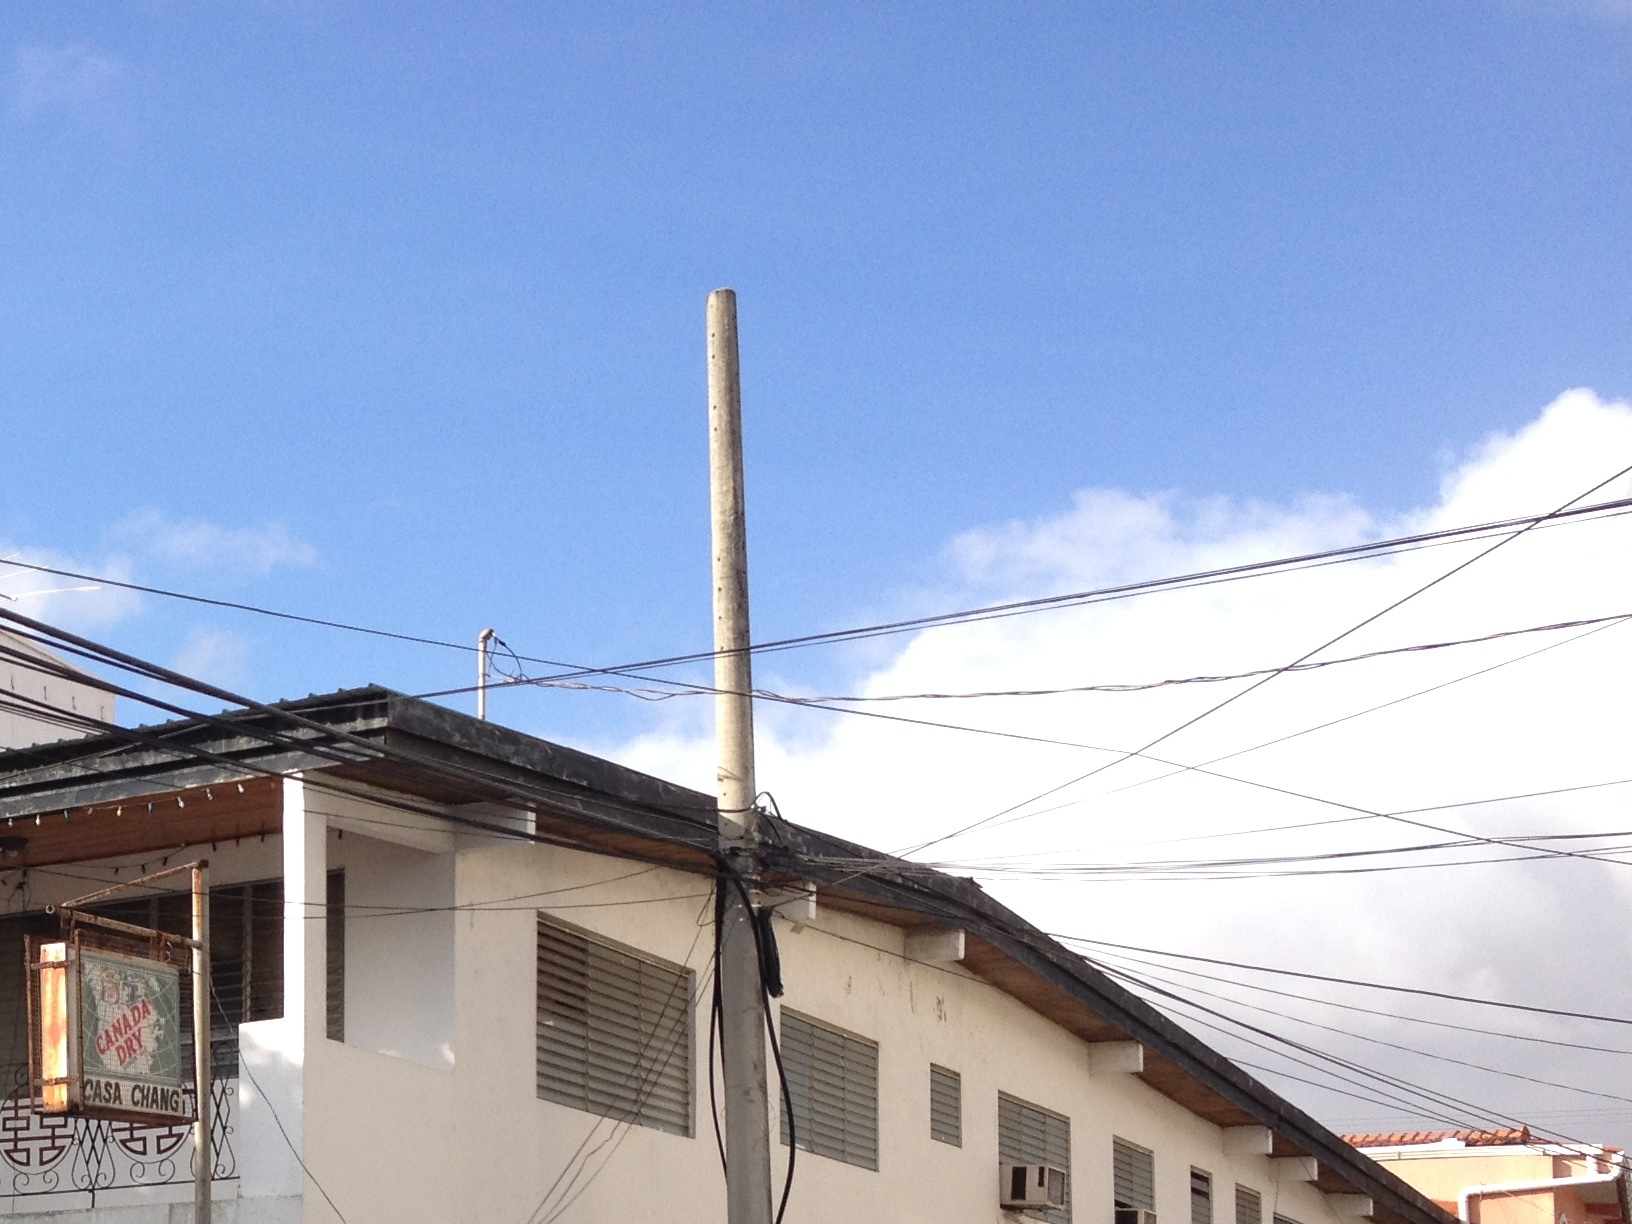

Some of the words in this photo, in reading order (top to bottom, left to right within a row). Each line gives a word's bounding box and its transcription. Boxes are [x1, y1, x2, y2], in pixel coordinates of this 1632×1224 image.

[96, 997, 151, 1056] CANADA
[115, 1027, 144, 1066] DRY
[84, 1079, 123, 1105] CASA
